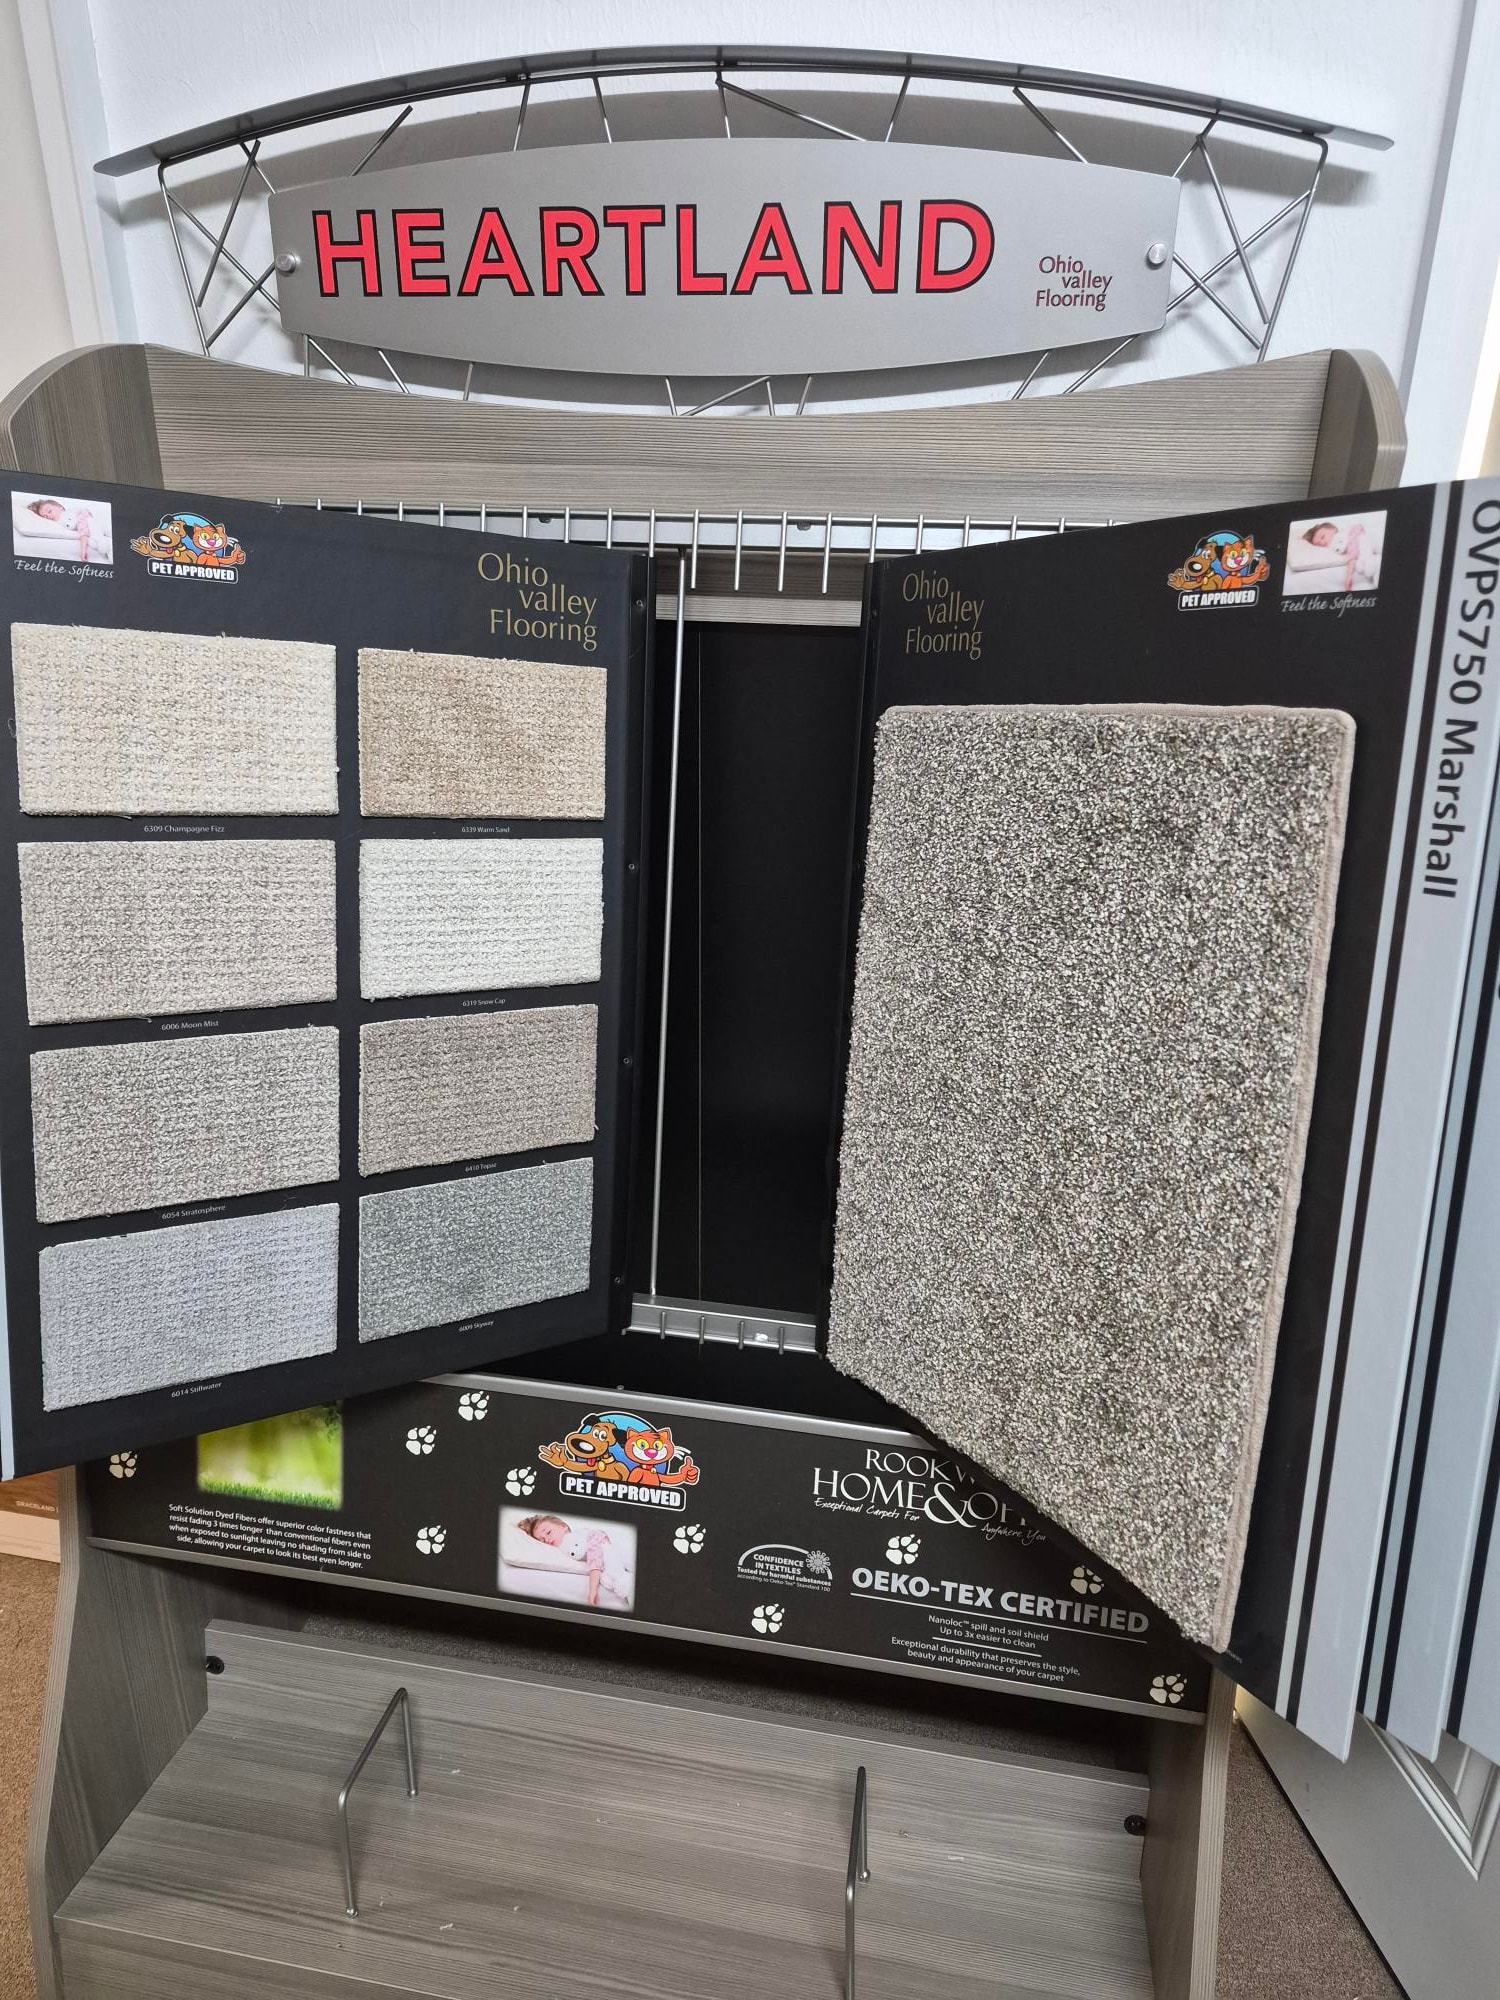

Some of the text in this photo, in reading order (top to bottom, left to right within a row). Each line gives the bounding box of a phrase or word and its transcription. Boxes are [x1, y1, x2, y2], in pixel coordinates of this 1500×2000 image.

[312, 198, 996, 298] HEARTLAND
[1038, 254, 1084, 274] Ohio
[1061, 269, 1113, 294] valley
[1035, 288, 1107, 312] Flooring
[13, 559, 114, 583] Feel the Softness
[151, 561, 236, 581] PET APPROVED
[477, 552, 548, 587] Ohio
[902, 569, 949, 602] Ohio
[518, 583, 598, 625] valley
[927, 590, 985, 631] valley
[1181, 590, 1256, 608] PET APPROVED
[1281, 593, 1378, 618] Feel the Softness
[490, 608, 598, 652] Flooring
[905, 624, 983, 661] Flooring
[1422, 499, 1500, 899] OVPS750 Marshall
[143, 824, 225, 834] 6309 Champagne Fizz
[161, 1023, 180, 1031] 6006
[161, 1205, 226, 1220] 6054 Stratosphere
[565, 1476, 681, 1507] PET APPROVED
[168, 1503, 372, 1541] Soft Solution Dyed Fibers offer superior color fastness that
[814, 1498, 920, 1521] Exceptional Carpets For
[168, 1523, 372, 1560] when exposed to sunlight leaving no shading from side to
[169, 1514, 371, 1550] resist fading 3 times longer than conventional fibers even
[980, 1522, 1023, 1541] Anywhere
[176, 1534, 364, 1570] side, allowing your carpet to look its best even longer.
[753, 1553, 804, 1568] CONFIDENCE
[737, 1566, 832, 1587] Tested for harmful substances
[764, 1563, 802, 1575] TEXTILES
[851, 1567, 1150, 1634] OEKO-TEX CERTIFIED
[940, 1625, 1036, 1649] Up to 3x easier to clean
[970, 1621, 988, 1631] spill
[989, 1626, 1006, 1634] and
[1007, 1628, 1022, 1637] soil
[1023, 1630, 1049, 1642] shield
[891, 1636, 1081, 1676] Exceptional durability that preserves the style,
[906, 1648, 1065, 1683] beauty and appearance of your carpet
